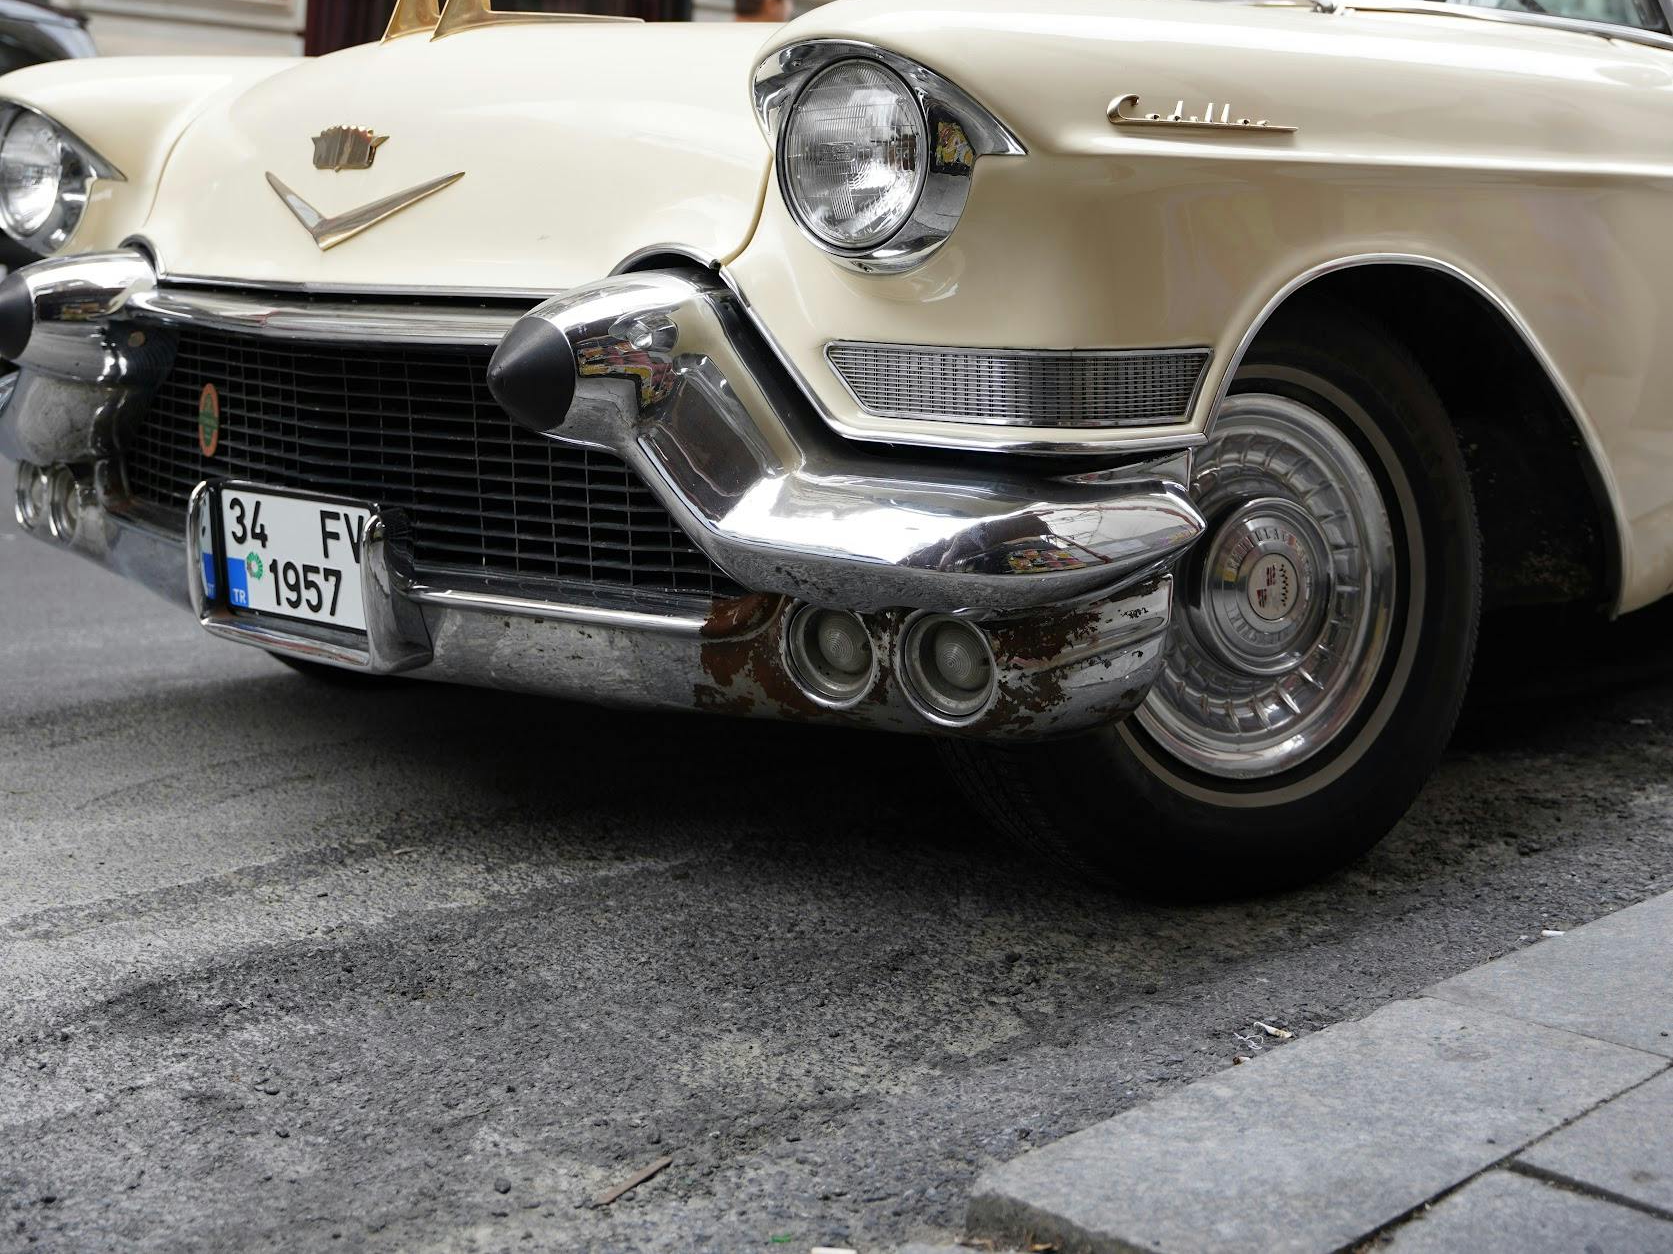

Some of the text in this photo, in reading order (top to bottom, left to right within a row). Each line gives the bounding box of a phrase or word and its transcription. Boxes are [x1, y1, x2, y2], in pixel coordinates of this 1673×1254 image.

[229, 497, 364, 564] 34 FV
[232, 588, 247, 605] TR
[269, 558, 342, 617] 1957
